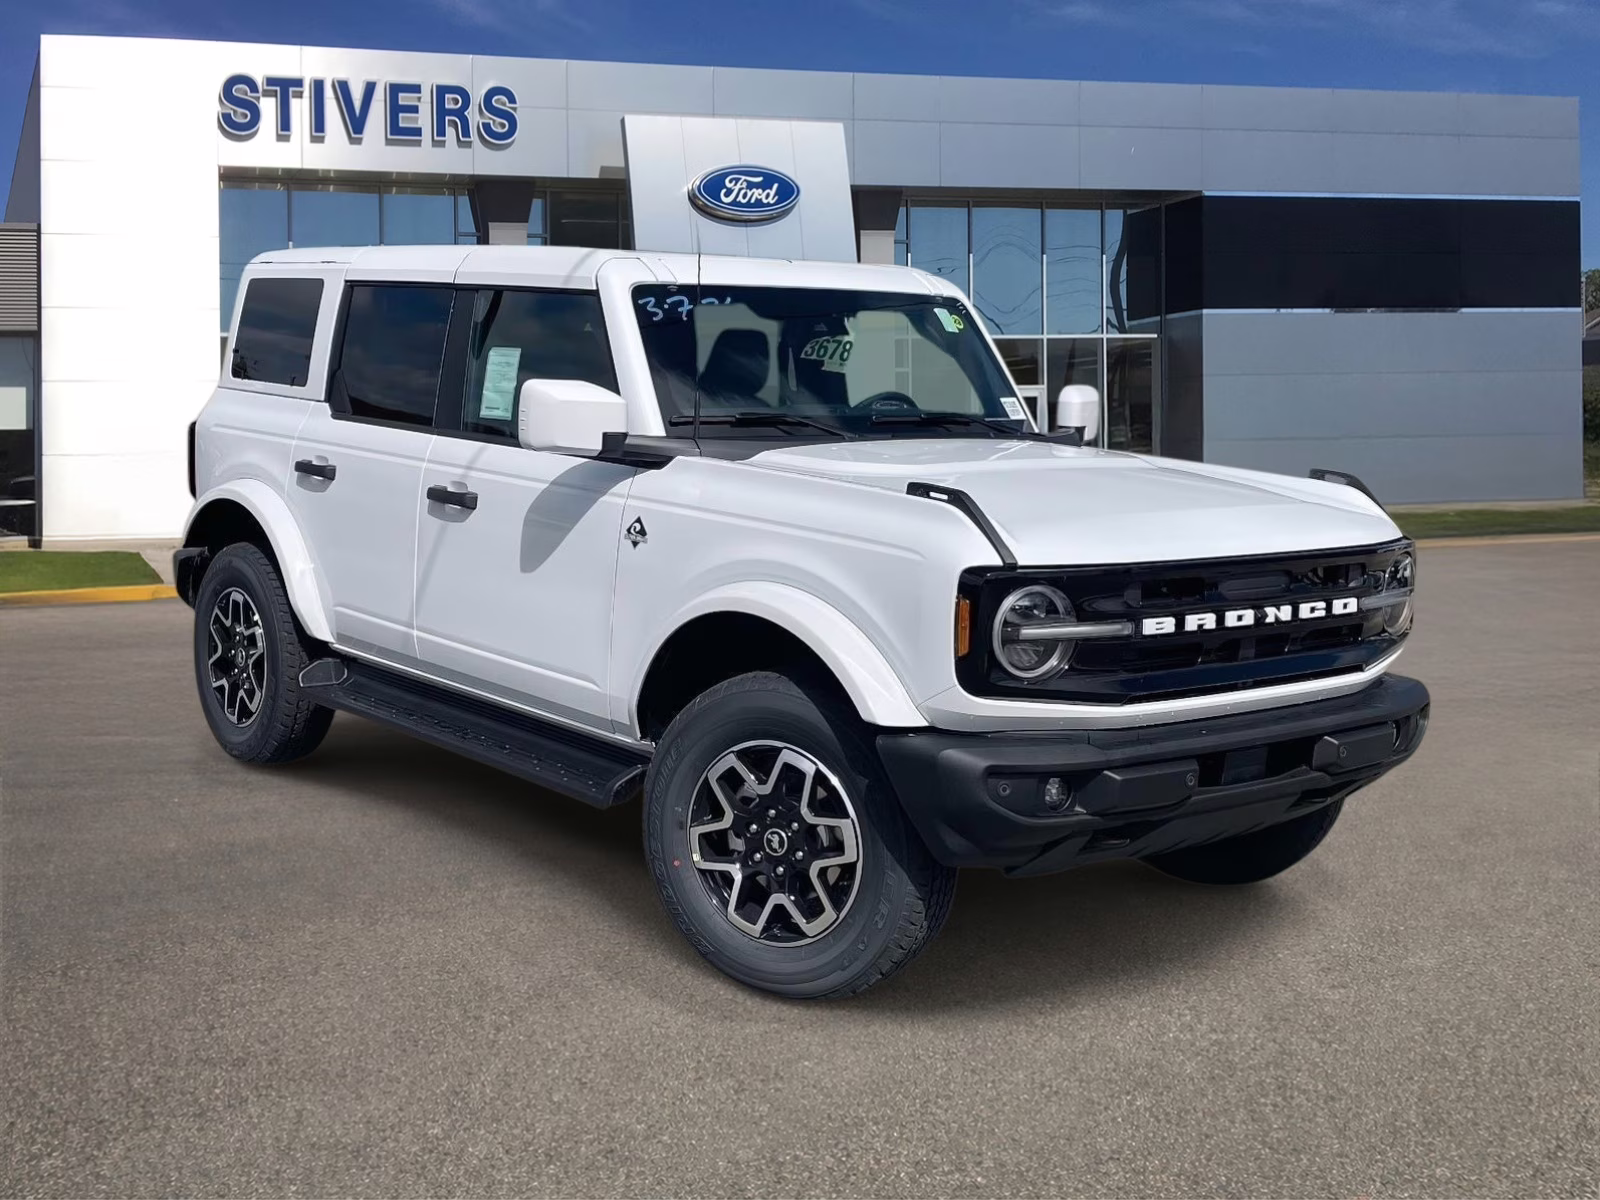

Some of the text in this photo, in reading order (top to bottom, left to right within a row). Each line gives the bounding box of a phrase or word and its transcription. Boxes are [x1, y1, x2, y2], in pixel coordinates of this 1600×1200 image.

[217, 73, 519, 148] STIVERS
[720, 174, 779, 204] Ford
[803, 338, 853, 363] 3678
[1142, 597, 1358, 635] BRONCO
